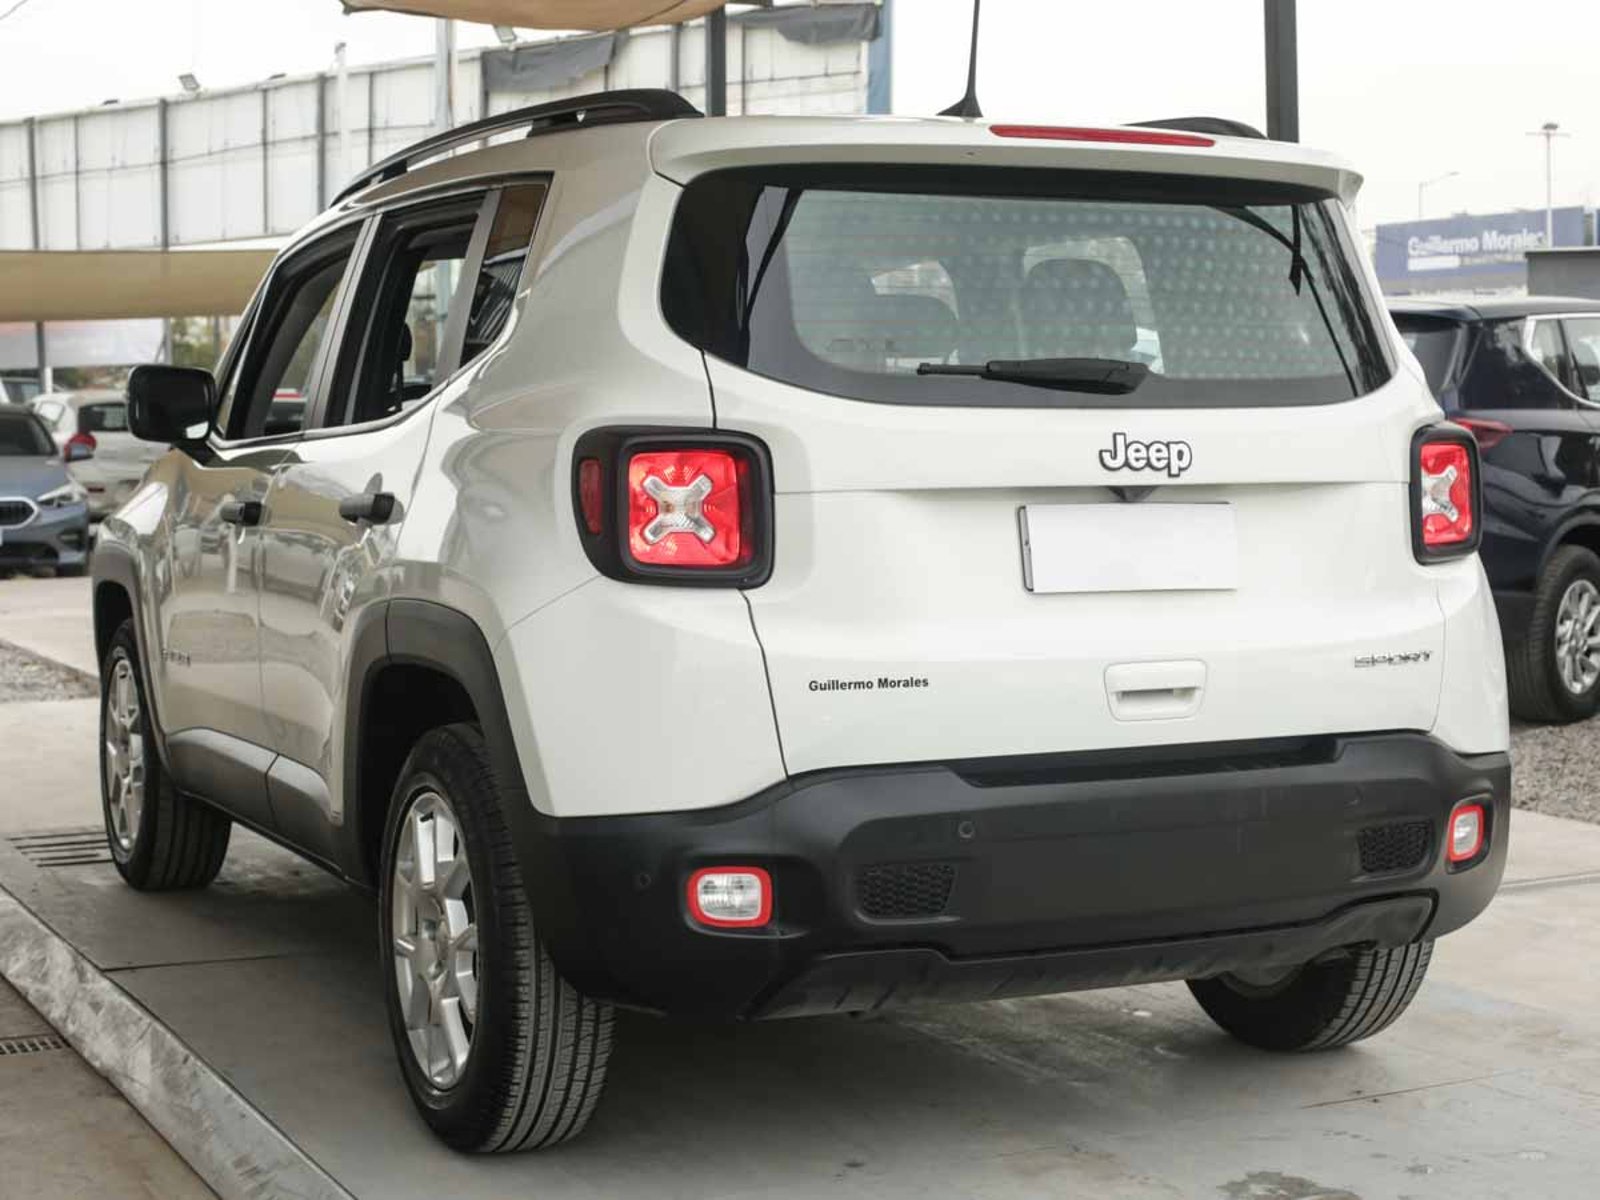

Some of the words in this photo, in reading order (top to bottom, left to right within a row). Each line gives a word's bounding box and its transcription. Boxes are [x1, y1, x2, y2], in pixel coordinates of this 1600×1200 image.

[1408, 235, 1479, 255] Guillermo
[1099, 432, 1192, 477] Jeep
[1354, 650, 1433, 668] SPORT
[808, 680, 874, 691] Guillermo
[877, 677, 929, 689] Morales
